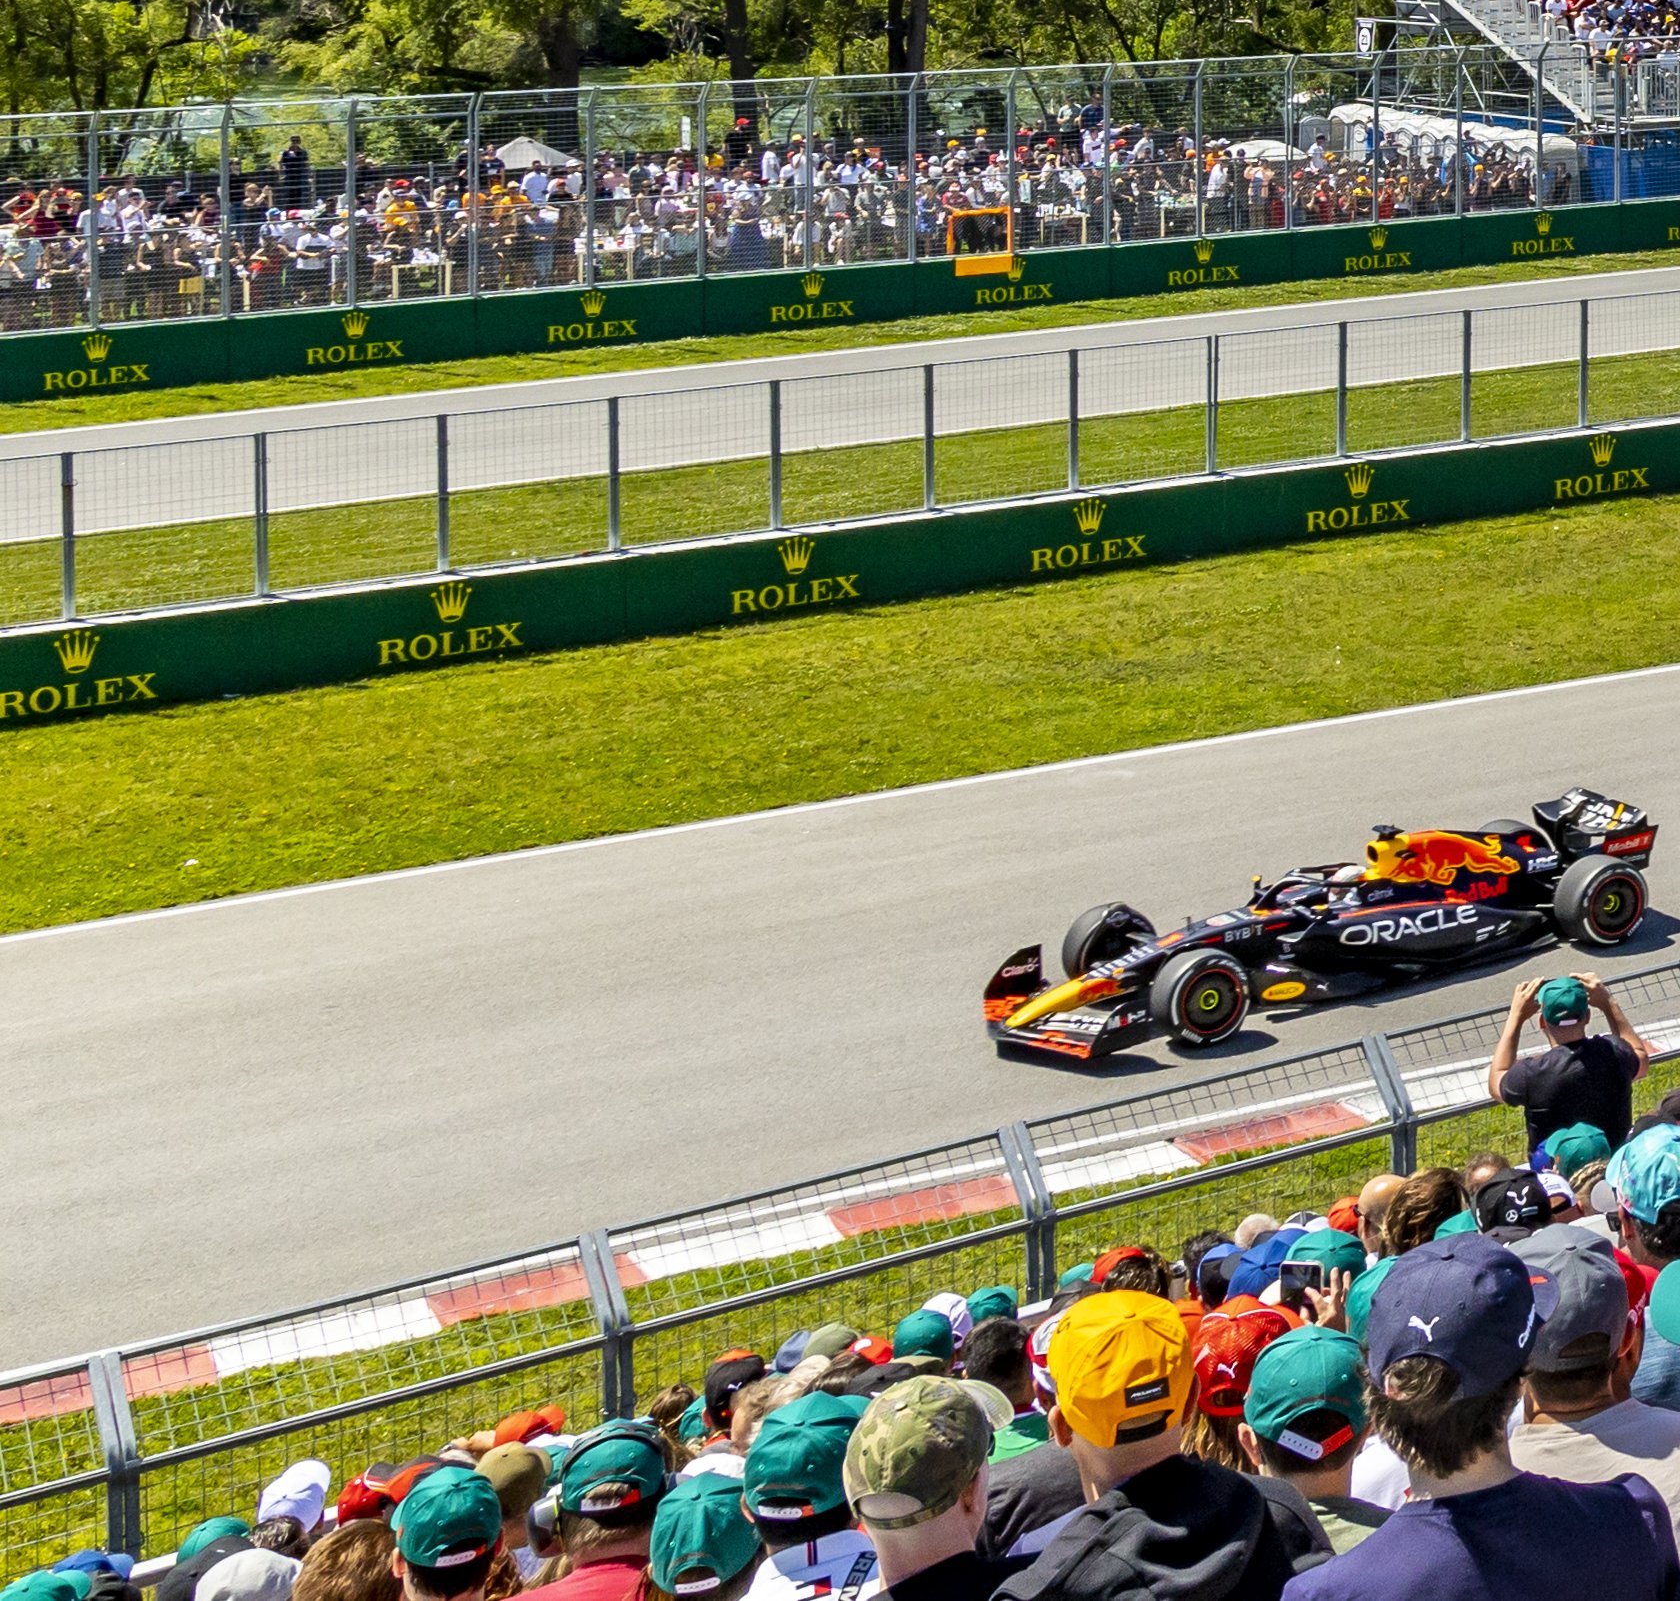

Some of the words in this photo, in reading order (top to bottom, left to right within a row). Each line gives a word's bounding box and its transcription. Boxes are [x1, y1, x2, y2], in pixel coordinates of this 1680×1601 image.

[1513, 238, 1574, 254] ROLEX
[1345, 252, 1411, 271] ROLEX
[1169, 266, 1239, 285] ROLEX
[977, 284, 1052, 303] ROLEX
[771, 301, 853, 321] ROLEX
[548, 320, 637, 342] ROLEX
[307, 341, 403, 364] ROLEX
[44, 365, 149, 390] ROLEX
[1555, 468, 1649, 498] ROLEX
[1307, 500, 1409, 532] ROLEX
[1031, 535, 1146, 571] ROLEX
[732, 575, 859, 613] ROLEX
[378, 622, 522, 664] ROLEX
[0, 673, 156, 718] ROLEX
[1444, 883, 1477, 903] Red
[1477, 876, 1508, 898] Bull
[1340, 904, 1479, 946] ORACLE
[1001, 963, 1036, 978] Claro
